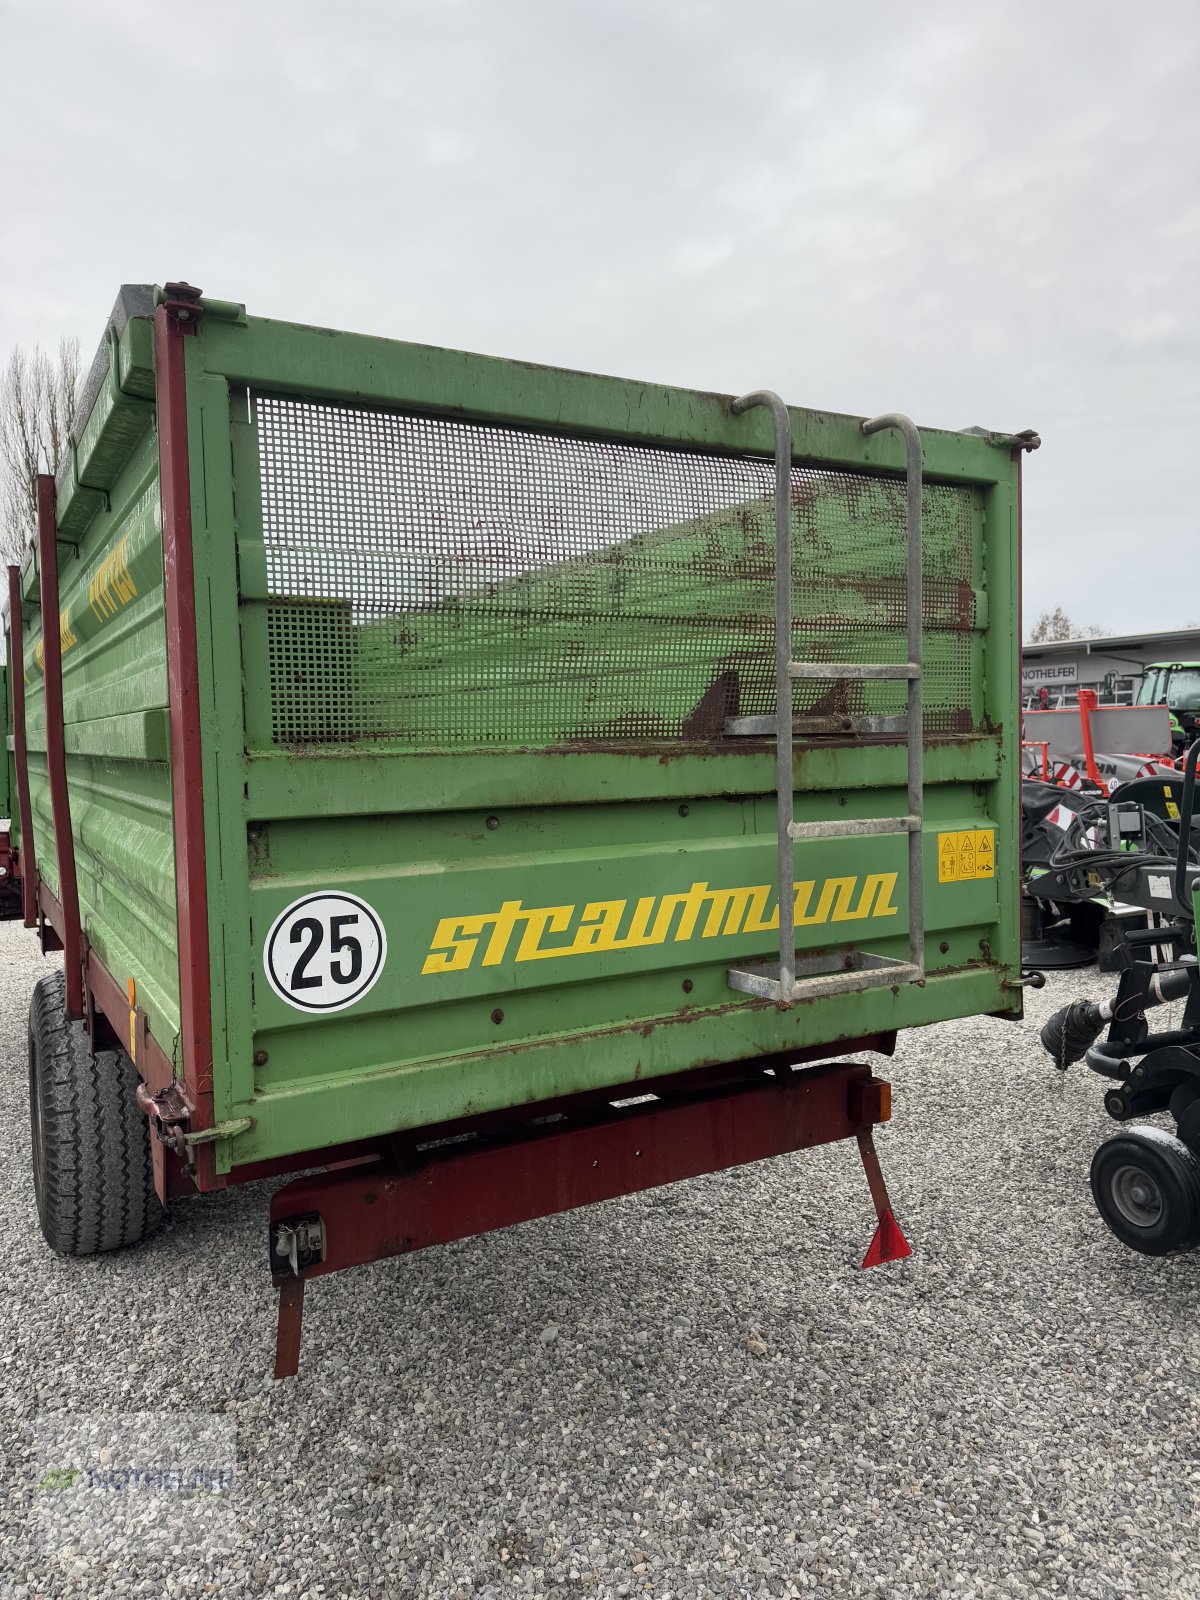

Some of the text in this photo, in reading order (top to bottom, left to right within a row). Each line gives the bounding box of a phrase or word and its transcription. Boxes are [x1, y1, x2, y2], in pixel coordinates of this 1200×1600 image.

[1022, 666, 1075, 680] NOTHELFER
[290, 914, 362, 990] 25
[421, 872, 898, 975] strautmann
